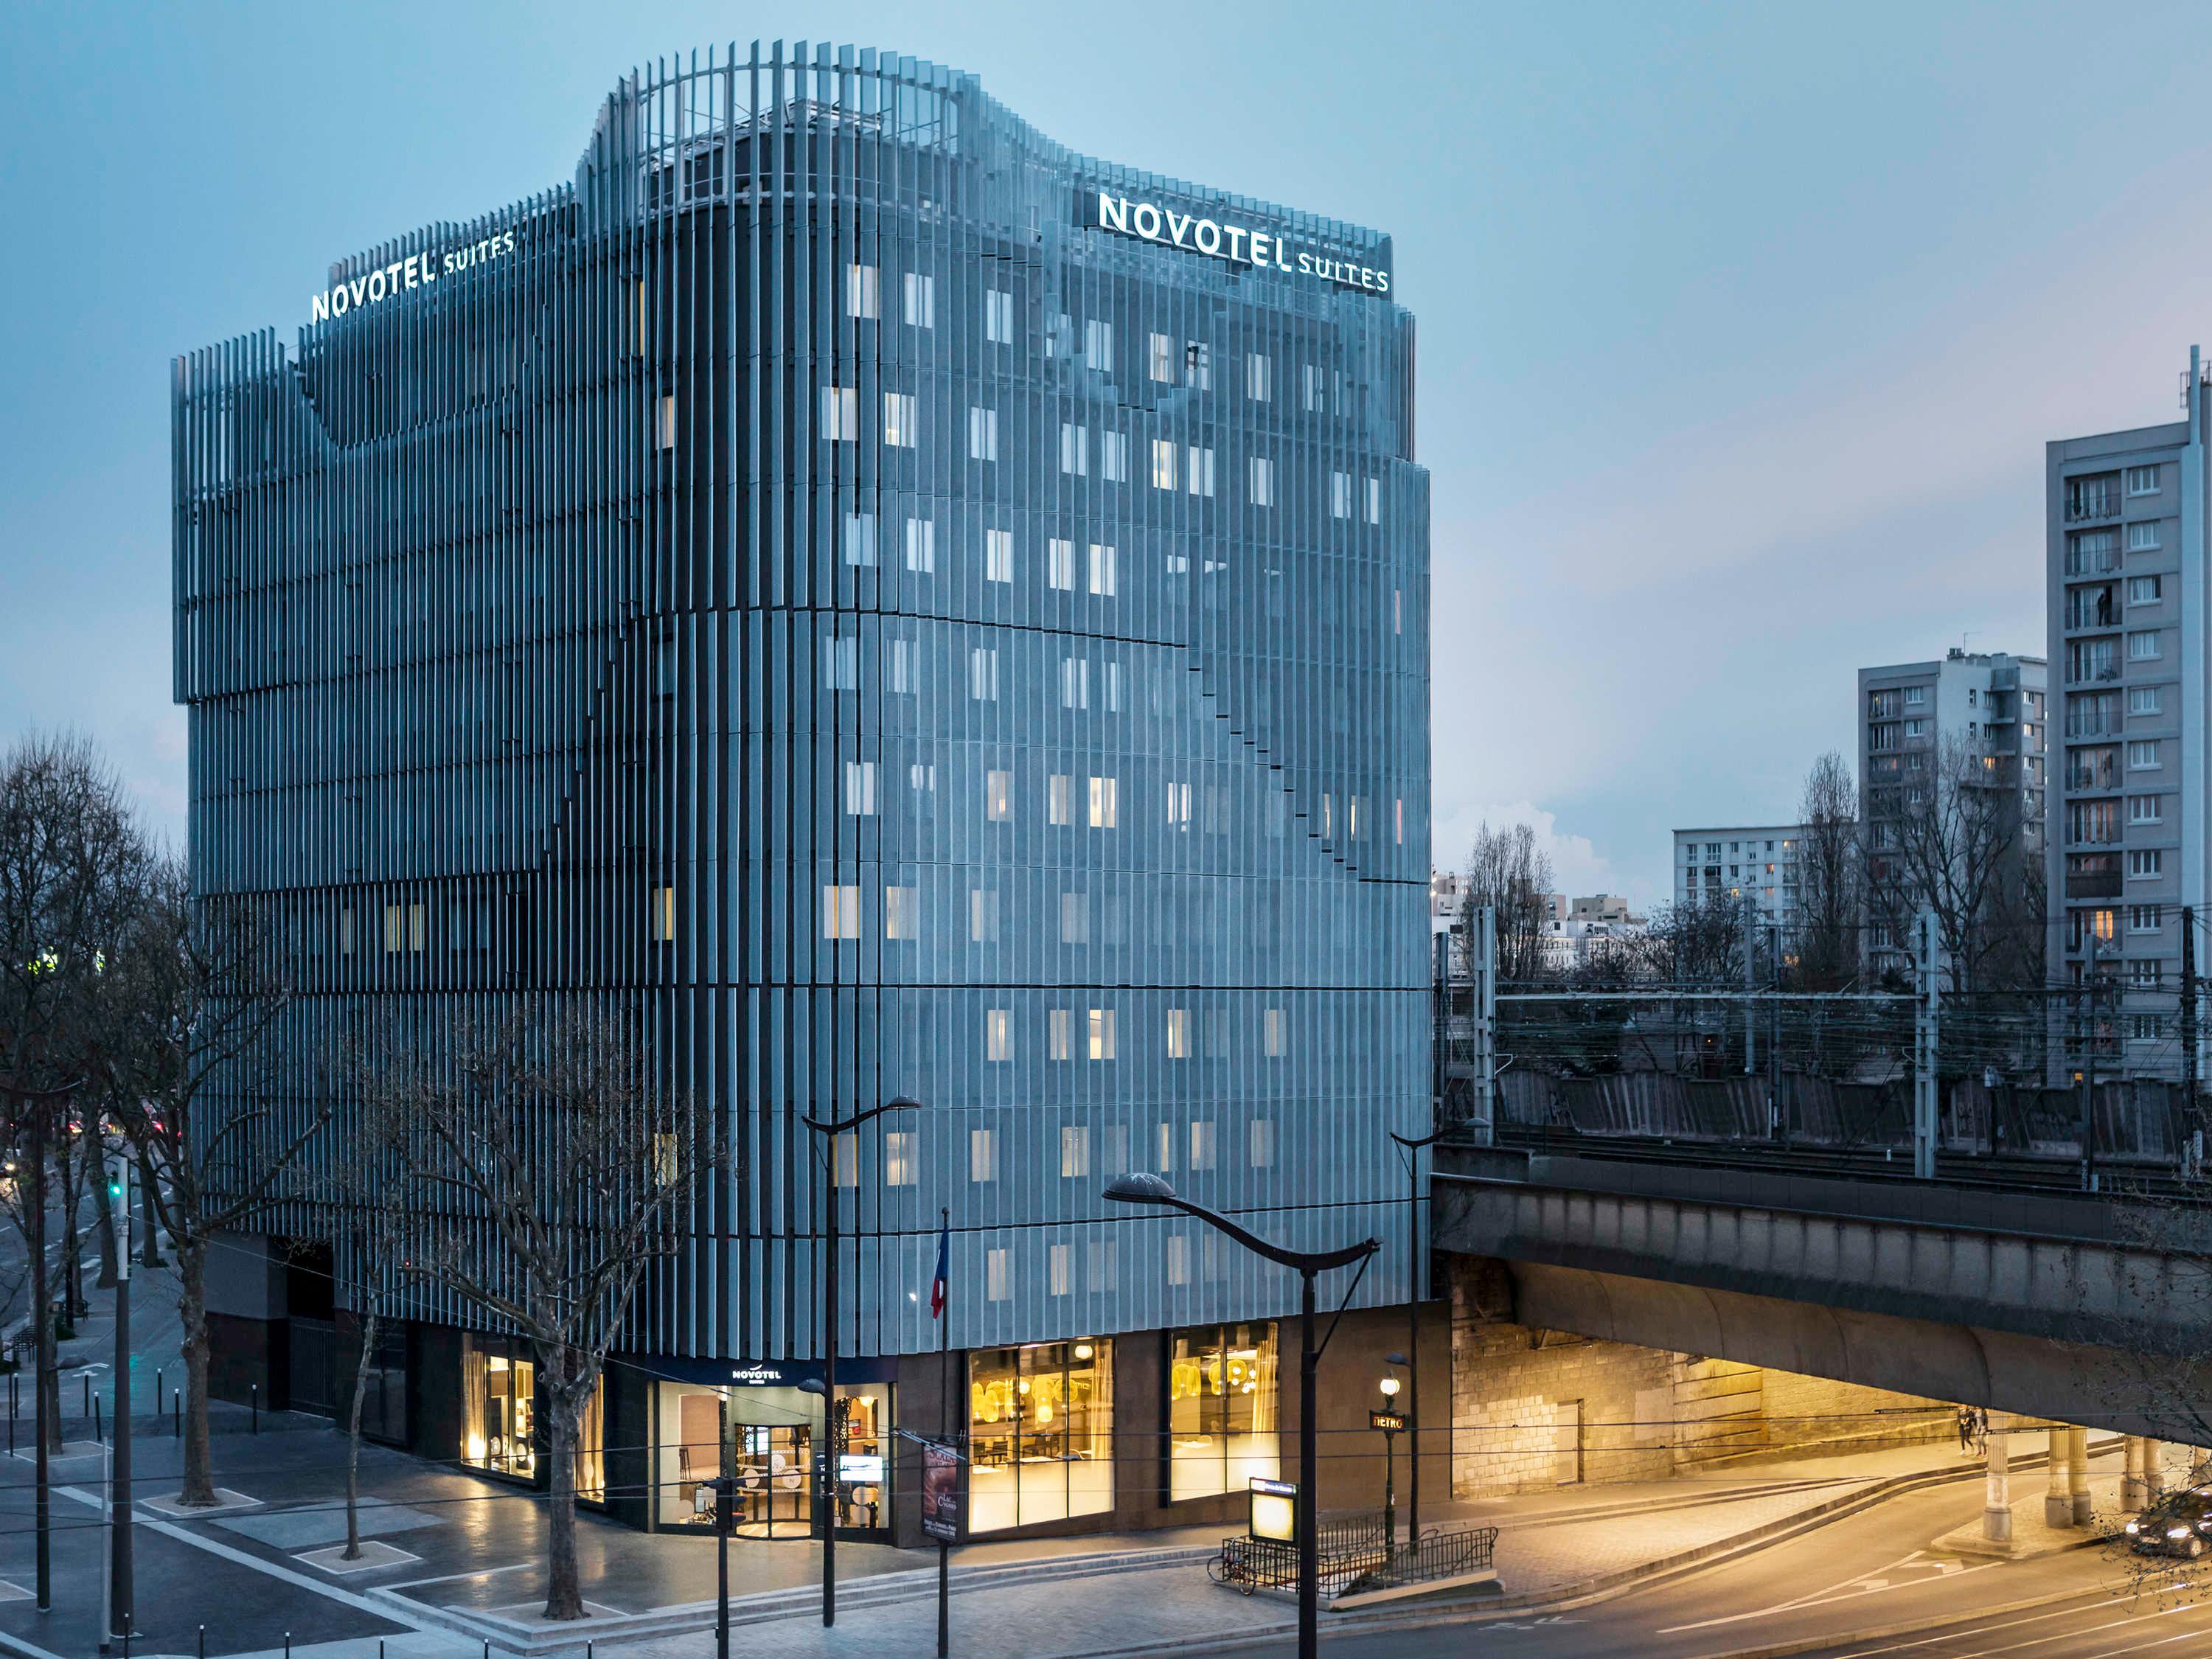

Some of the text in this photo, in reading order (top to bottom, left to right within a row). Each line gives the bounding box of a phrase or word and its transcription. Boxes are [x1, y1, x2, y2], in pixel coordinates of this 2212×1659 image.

[312, 232, 513, 325] NOVOTEL SUITES
[1098, 192, 1389, 292] NOVOTEL SUITES
[732, 1371, 782, 1379] NOVOTEL
